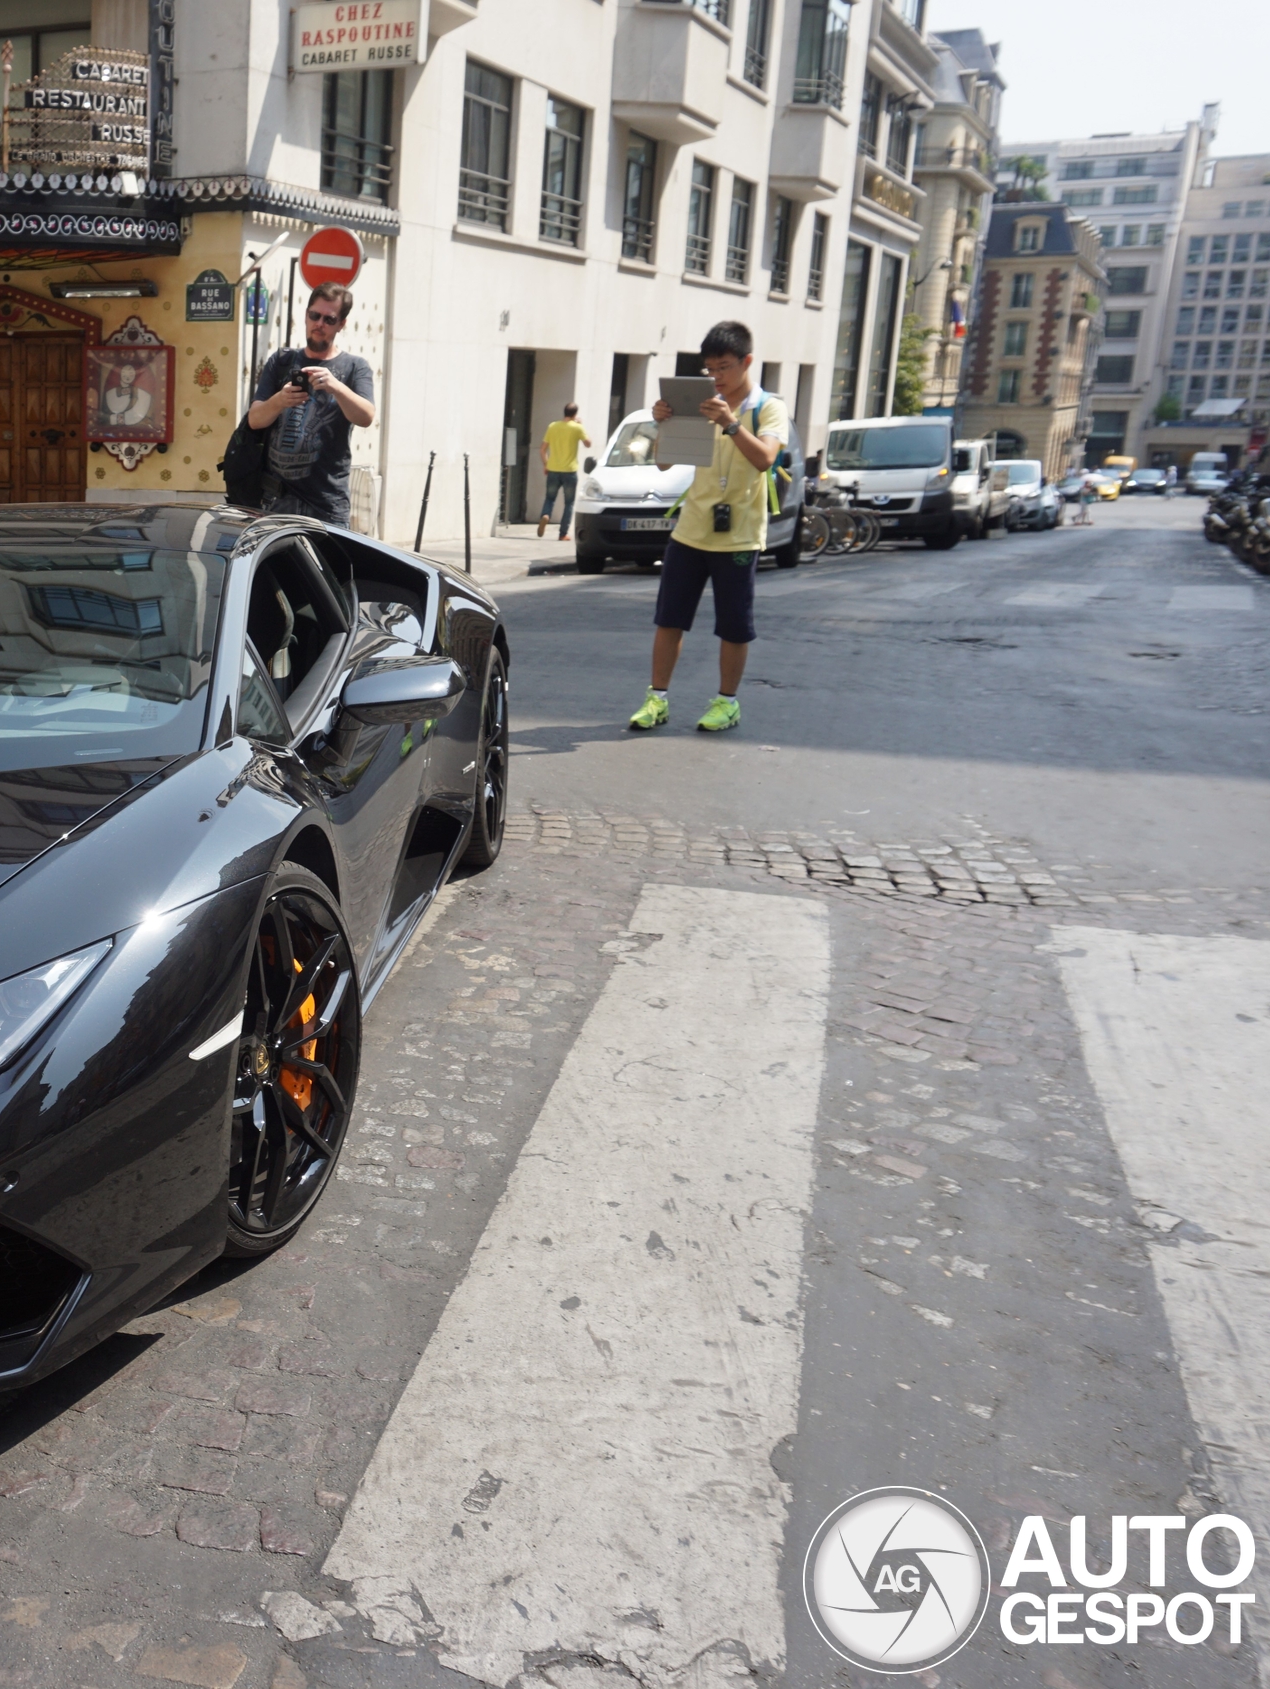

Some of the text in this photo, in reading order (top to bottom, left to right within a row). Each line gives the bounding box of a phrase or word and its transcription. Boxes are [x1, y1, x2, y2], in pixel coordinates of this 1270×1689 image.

[335, 3, 383, 22] CHEZ
[301, 21, 415, 47] RASPOUTINE
[302, 44, 412, 66] CABARET RUSSE
[76, 62, 149, 84] CABARET
[32, 89, 146, 115] RESTAURANT
[100, 124, 151, 144] RUSSE
[201, 289, 220, 297] RUE
[191, 302, 230, 310] BASSANO
